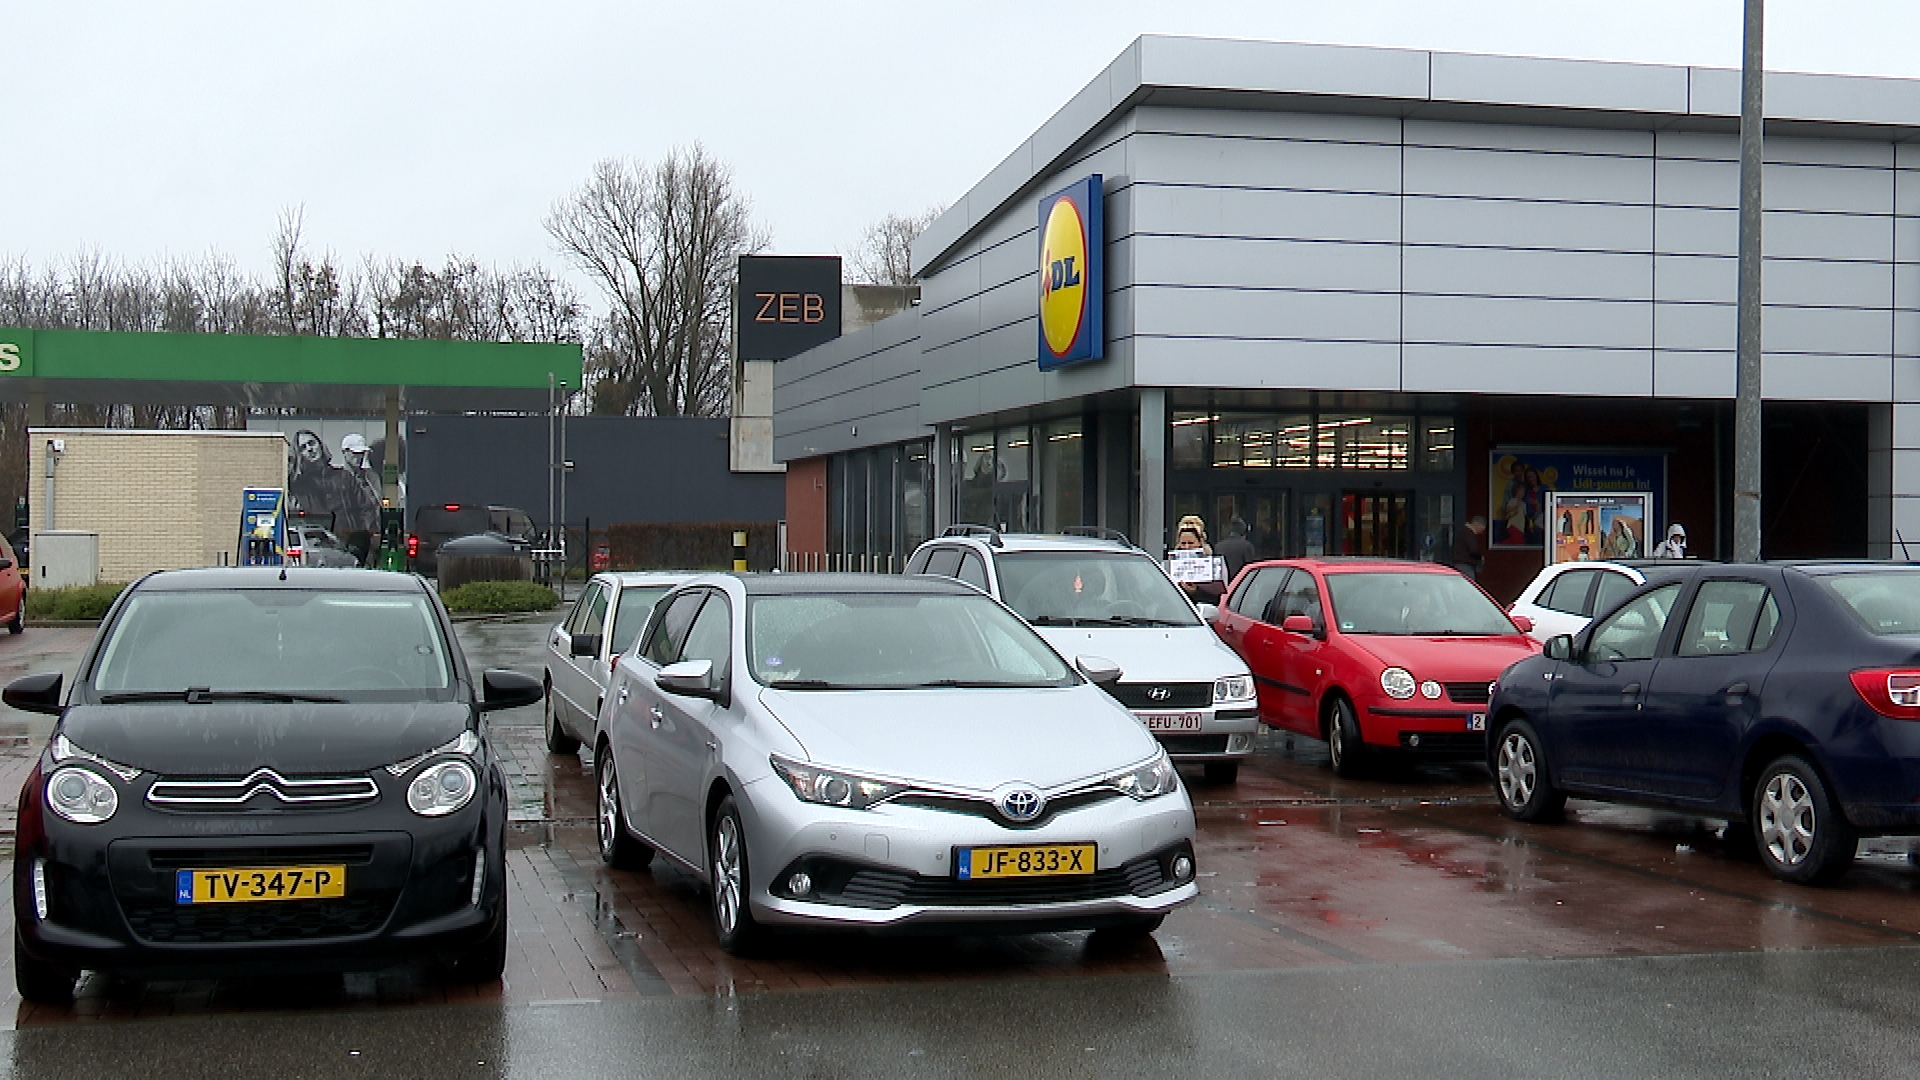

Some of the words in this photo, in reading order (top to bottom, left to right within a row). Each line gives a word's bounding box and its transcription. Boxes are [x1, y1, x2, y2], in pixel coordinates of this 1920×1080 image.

[755, 293, 824, 323] ZEB
[1573, 465, 1607, 477] Wissel
[1609, 467, 1623, 477] nu
[1625, 465, 1636, 478] je
[1573, 478, 1634, 490] Lidl-punten
[1138, 716, 1199, 729] -EFU-701
[982, 850, 1083, 873] JF-833-X
[179, 889, 191, 899] NL
[205, 871, 331, 898] TV-347-P
